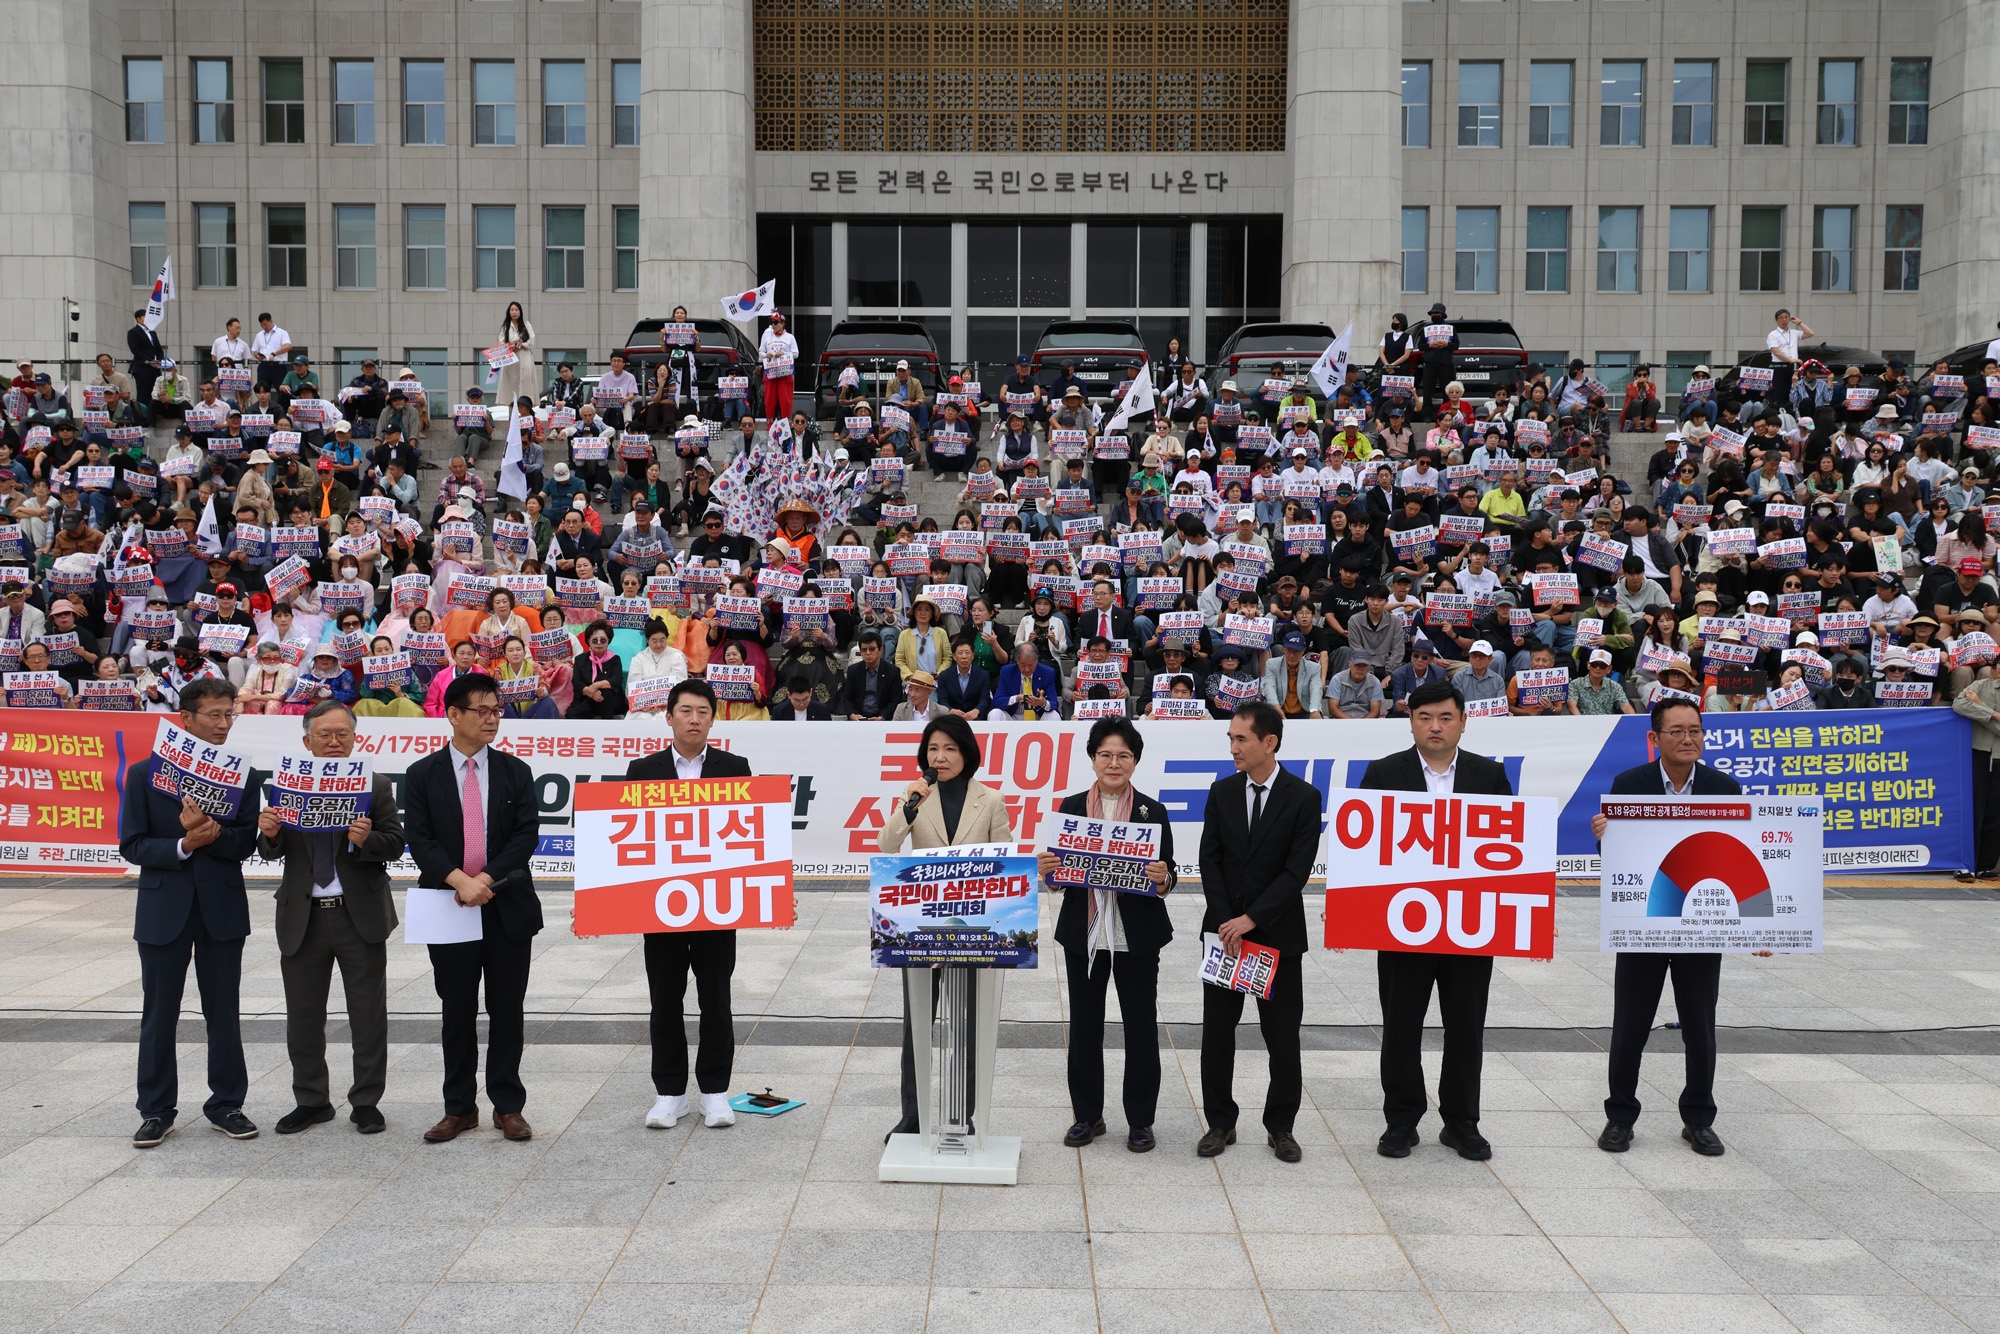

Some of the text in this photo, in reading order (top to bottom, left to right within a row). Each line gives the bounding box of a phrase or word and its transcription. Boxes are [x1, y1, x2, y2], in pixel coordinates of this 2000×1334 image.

[809, 170, 1228, 193] 모든 권력은 국민으로부터 나온다
[1823, 619, 1868, 629] 진실을 밝혀라
[1825, 612, 1867, 622] 부정선거
[712, 666, 751, 675] 부정선거
[1522, 676, 1566, 687] 진실을 밝혀라
[1523, 670, 1564, 679] 부정선거
[29, 690, 52, 698] 유공자
[1526, 688, 1540, 696] 518
[1718, 677, 1754, 689] 재선거
[1883, 684, 1928, 692] 부정선거
[1881, 691, 1929, 699] 진실을 밝혀라
[11, 734, 104, 758] 폐기하라
[496, 736, 596, 758] 소금혁명을
[1750, 727, 1813, 748] 진실을
[1819, 724, 1884, 747] 밝혀라
[166, 728, 242, 772] 부정선거
[159, 740, 242, 786] 진실을 밝혀라
[281, 756, 364, 776] 부정선거
[1781, 751, 1909, 777] 전면공개하라
[57, 770, 104, 792] 반대
[152, 773, 178, 795] 전면
[160, 762, 227, 803] 518 유공자
[277, 771, 366, 792] 진실을 밝혀라
[1824, 783, 1866, 802] 부터
[1871, 779, 1936, 801] 받아라
[280, 792, 356, 813] 518 유공자
[619, 782, 752, 807] 새천년NHK
[36, 806, 104, 829] 지켜라
[274, 806, 364, 829] 전면 공개하라
[1608, 806, 1622, 816] 5.18
[1623, 806, 1642, 817] 유공자
[1643, 806, 1656, 817] 명단
[1657, 806, 1670, 817] 공개
[1672, 806, 1691, 817] 필요성
[1758, 806, 1793, 816] 천지일보
[1860, 806, 1943, 829] 반대한다
[608, 806, 764, 866] 김민석
[1063, 818, 1152, 843] 부정선거
[1336, 795, 1525, 871] 이재명
[1761, 831, 1793, 844] 69.7%
[1058, 833, 1154, 858] 진실을 밝혀라
[1762, 849, 1791, 860] 필요하다
[911, 861, 994, 882] 국회의사당에서
[1063, 854, 1142, 875] 518 유공자
[1053, 866, 1152, 892] 전면 공개하라
[1611, 873, 1643, 886] 19.2%
[655, 875, 785, 928] OUT
[879, 875, 1031, 906] 국민이 심판한다
[1611, 891, 1647, 903] 불필요하다
[922, 900, 985, 918] 국민대회
[1387, 887, 1550, 950] OUT
